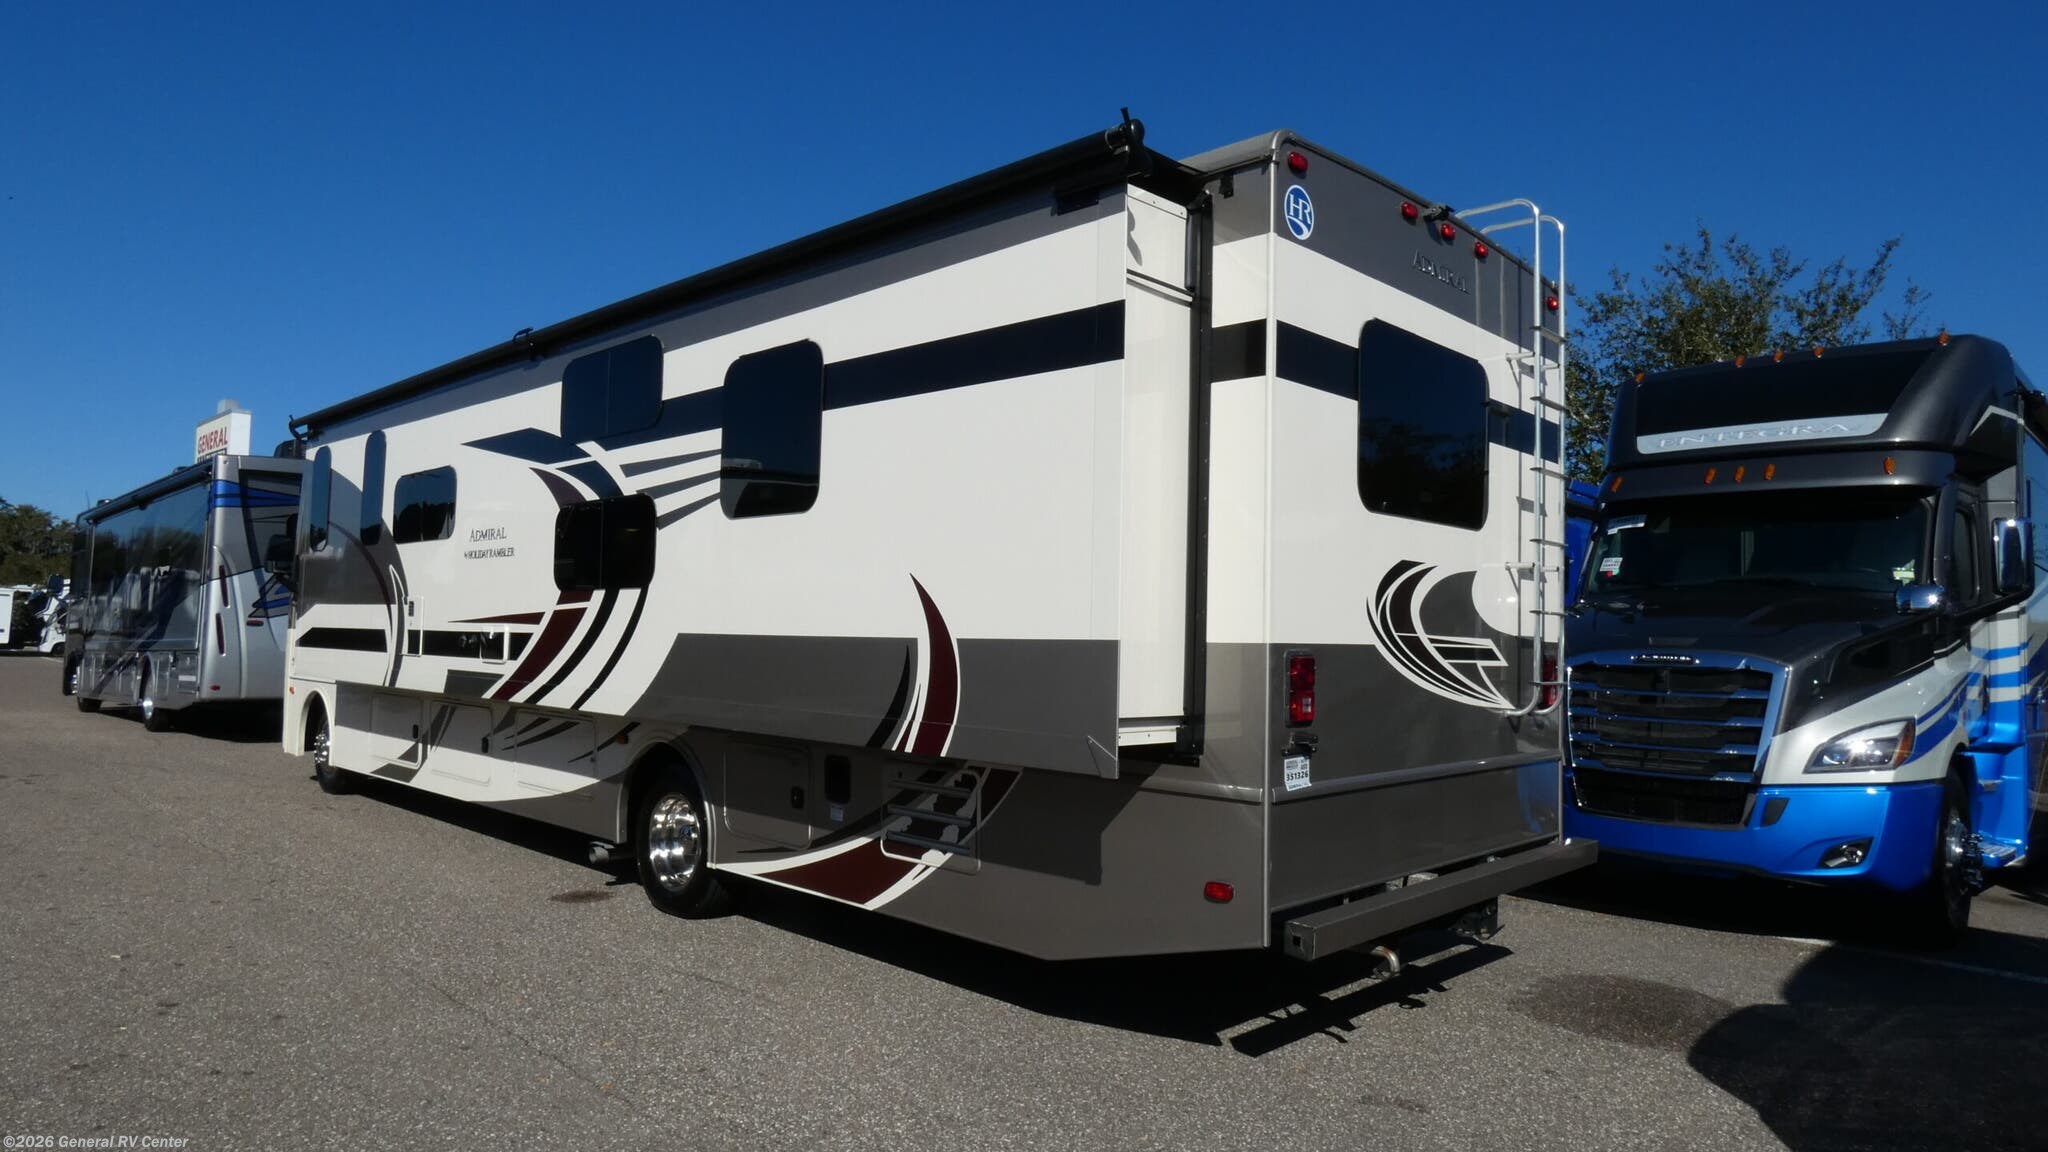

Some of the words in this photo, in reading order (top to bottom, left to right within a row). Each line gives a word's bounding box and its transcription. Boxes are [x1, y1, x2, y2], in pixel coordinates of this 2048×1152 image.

[1289, 192, 1311, 225] HR
[1411, 248, 1471, 296] ADMIRAL
[198, 426, 228, 455] GENERAL
[469, 527, 507, 542] ADMIRAL
